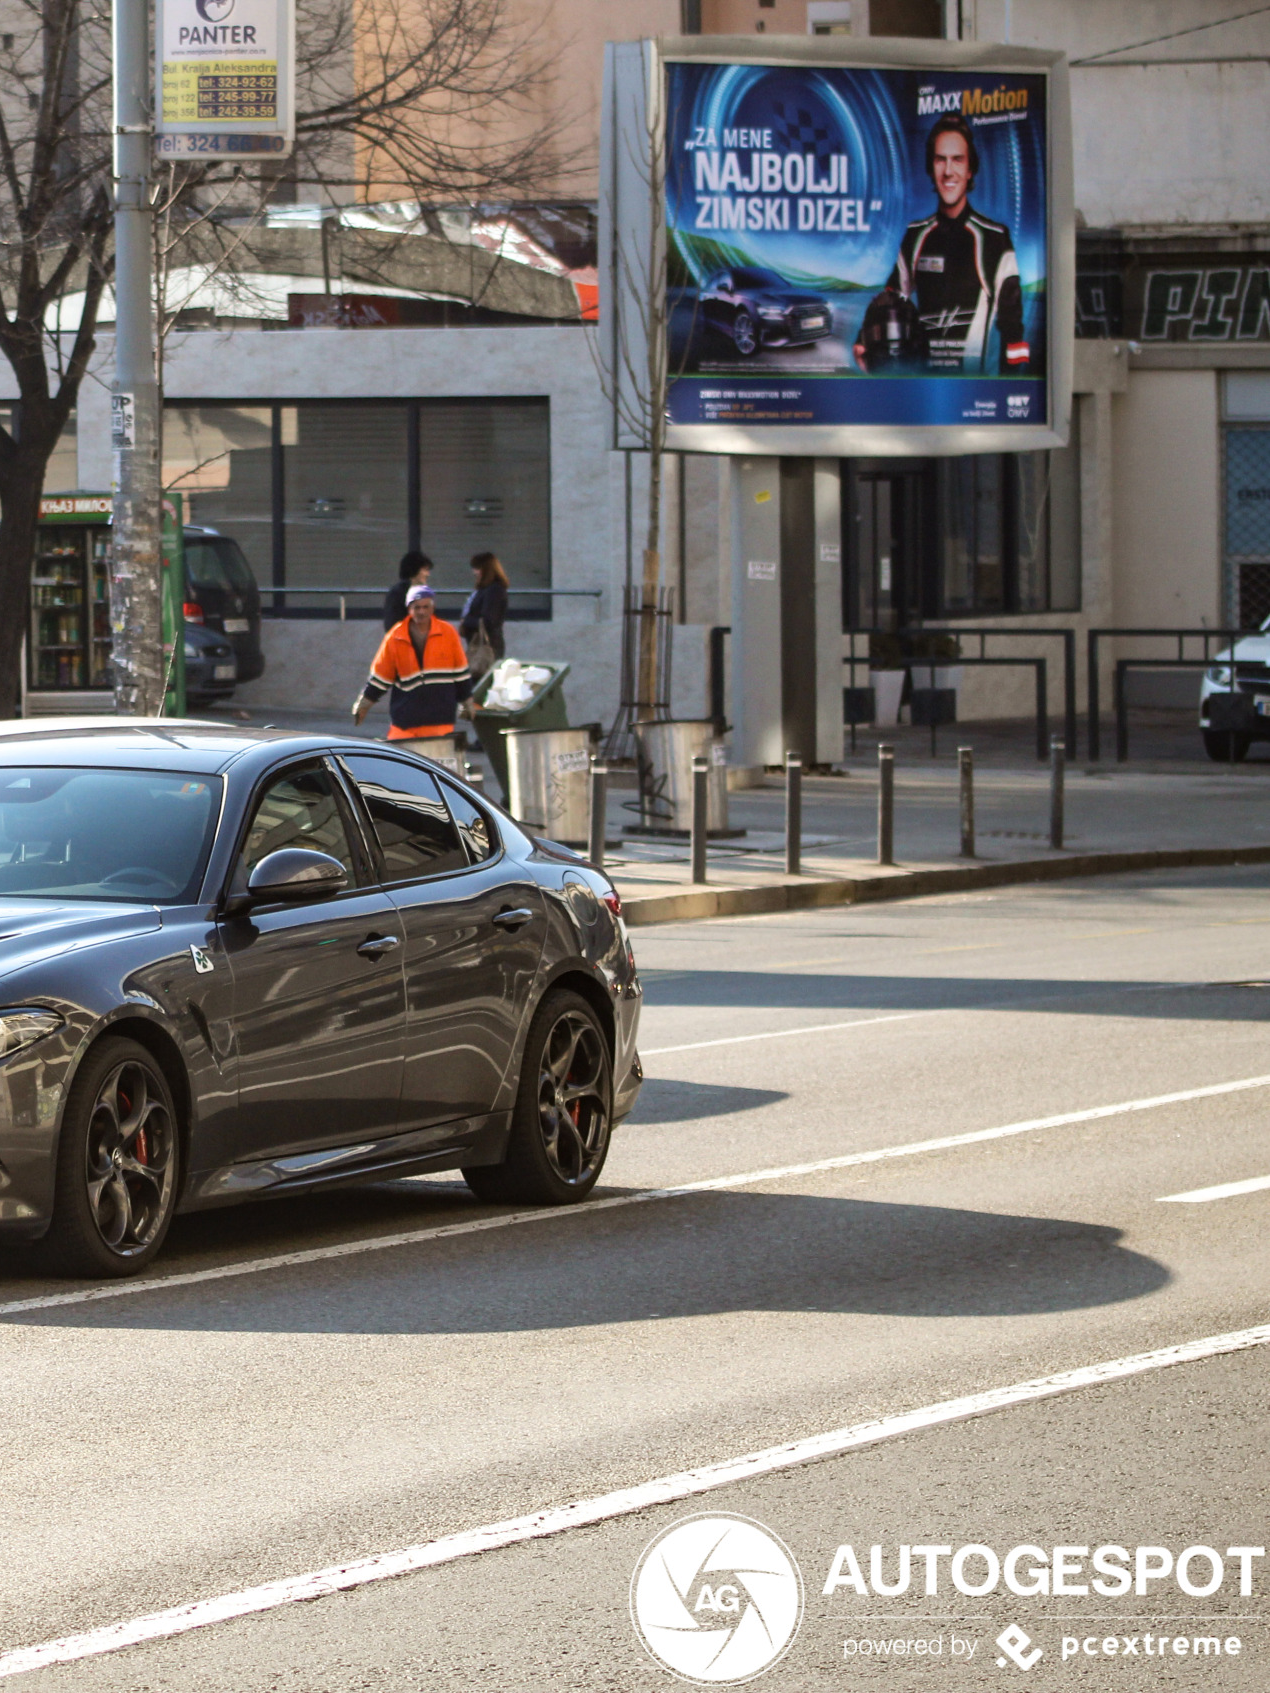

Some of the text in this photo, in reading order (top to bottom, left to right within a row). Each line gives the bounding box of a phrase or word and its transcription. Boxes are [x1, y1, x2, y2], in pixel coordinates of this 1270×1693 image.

[179, 25, 257, 46] PANTER
[182, 64, 210, 75] Kralja
[214, 63, 277, 73] Aleksandra
[199, 78, 215, 88] tel:
[218, 77, 274, 88] 324-92-62
[199, 92, 215, 102] tel:
[218, 92, 274, 102] 245-99-77
[199, 107, 215, 117] tel:
[218, 106, 274, 116] 242-39-59
[156, 135, 181, 152] Tel:
[187, 136, 220, 152] 324
[227, 135, 252, 151] 66
[724, 128, 772, 150] MENE
[695, 151, 848, 194] NAJBOLJI
[695, 197, 790, 231] ZIMSKI
[40, 500, 72, 513] КЊАЗ
